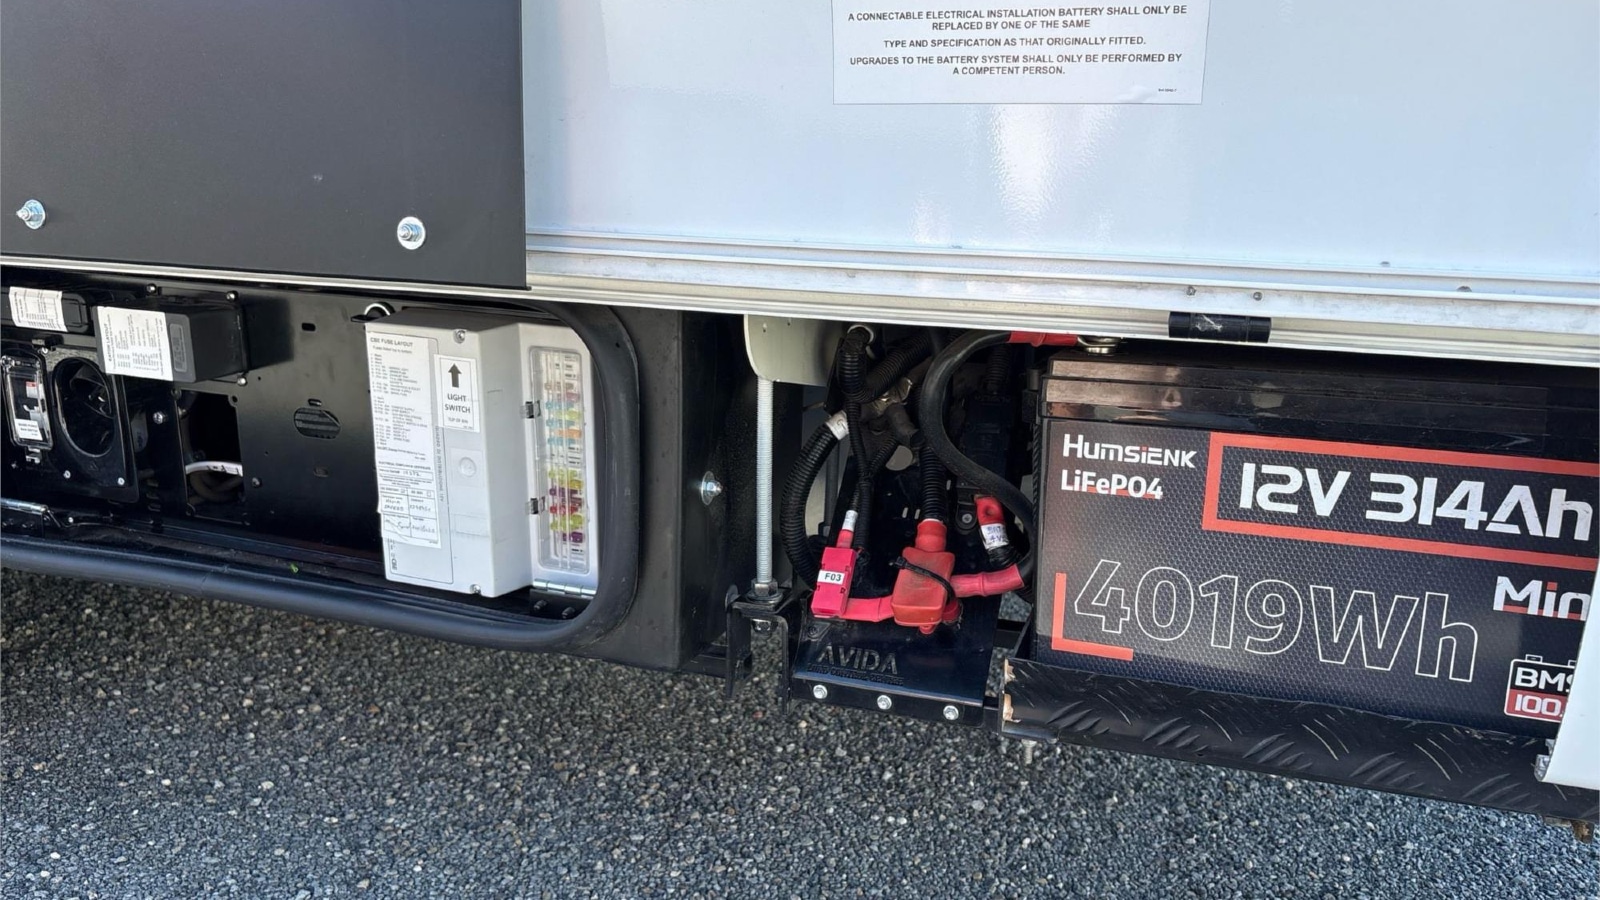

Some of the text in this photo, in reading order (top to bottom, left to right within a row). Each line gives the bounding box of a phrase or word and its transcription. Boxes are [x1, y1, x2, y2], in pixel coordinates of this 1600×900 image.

[848, 5, 1187, 21] A CONNECTABLE ELECTRICAL INSTALLATION BATTERY SHALL ONLY BE
[932, 20, 1091, 31] REPLACED BY ONE OF THE SAME
[884, 36, 1146, 48] TYPE AND SPECIFICATION AS THAT ORIGINALLY FITTED.
[850, 53, 1182, 65] UPGRADES TO THE BATTERY SYSTEM SHALL ONLY BE PERFORMED BY
[953, 66, 1066, 75] A COMPETENT PERSON.
[447, 393, 467, 402] LIGHT
[444, 403, 471, 414] SWITCH
[1239, 462, 1593, 541] 12V 314Ah
[824, 572, 842, 582] F03
[1074, 559, 1478, 682] 4019Wh
[817, 642, 898, 675] AVIDA
